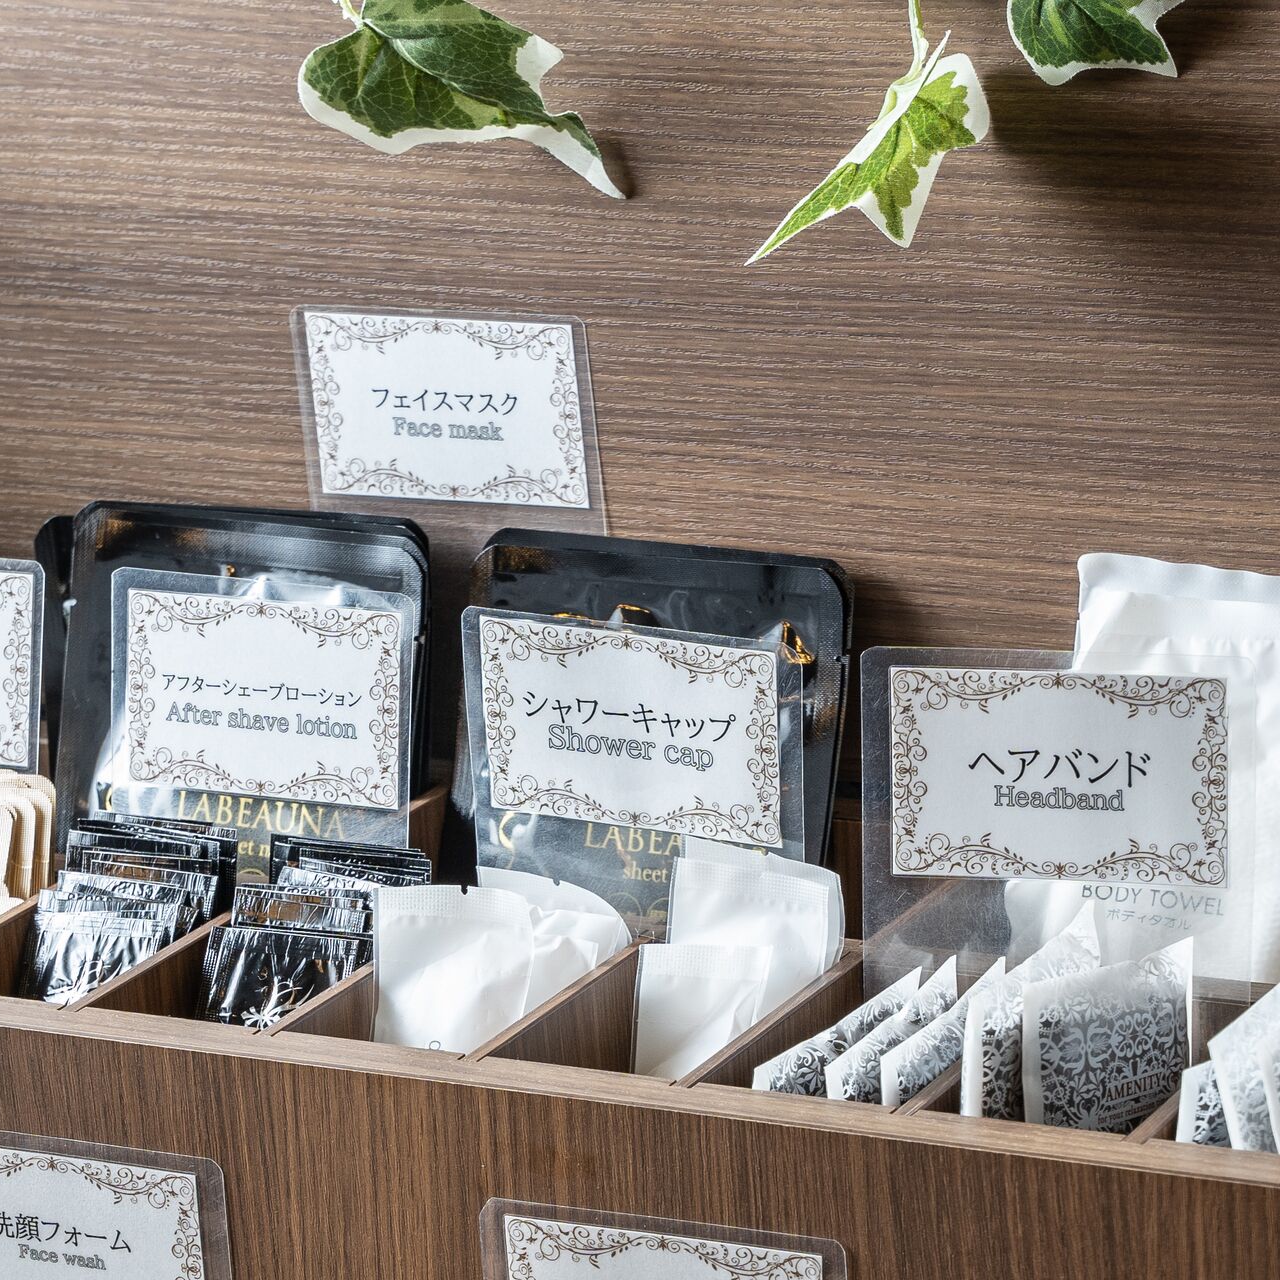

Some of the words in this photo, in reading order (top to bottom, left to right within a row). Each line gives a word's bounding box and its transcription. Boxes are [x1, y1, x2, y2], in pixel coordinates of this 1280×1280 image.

[371, 388, 518, 416] フェイスマスク
[392, 416, 442, 438] Face
[448, 422, 504, 441] mask
[161, 673, 362, 708] アフターシェーブローション
[166, 701, 223, 726] After
[227, 708, 290, 733] shave
[296, 714, 358, 740] lotion
[522, 691, 736, 742] シャワーキャップ
[548, 724, 656, 761] Shower
[663, 744, 714, 772] cap
[968, 748, 1151, 788] ヘアバンド
[993, 785, 1125, 812] Headband
[177, 790, 346, 840] LABEAUNA
[623, 864, 669, 884] sheet
[1081, 885, 1143, 904] BODY
[1150, 889, 1225, 916] TOWEL
[1105, 1072, 1163, 1103] AMENITY
[18, 1243, 59, 1264] Face
[62, 1252, 107, 1271] wash
